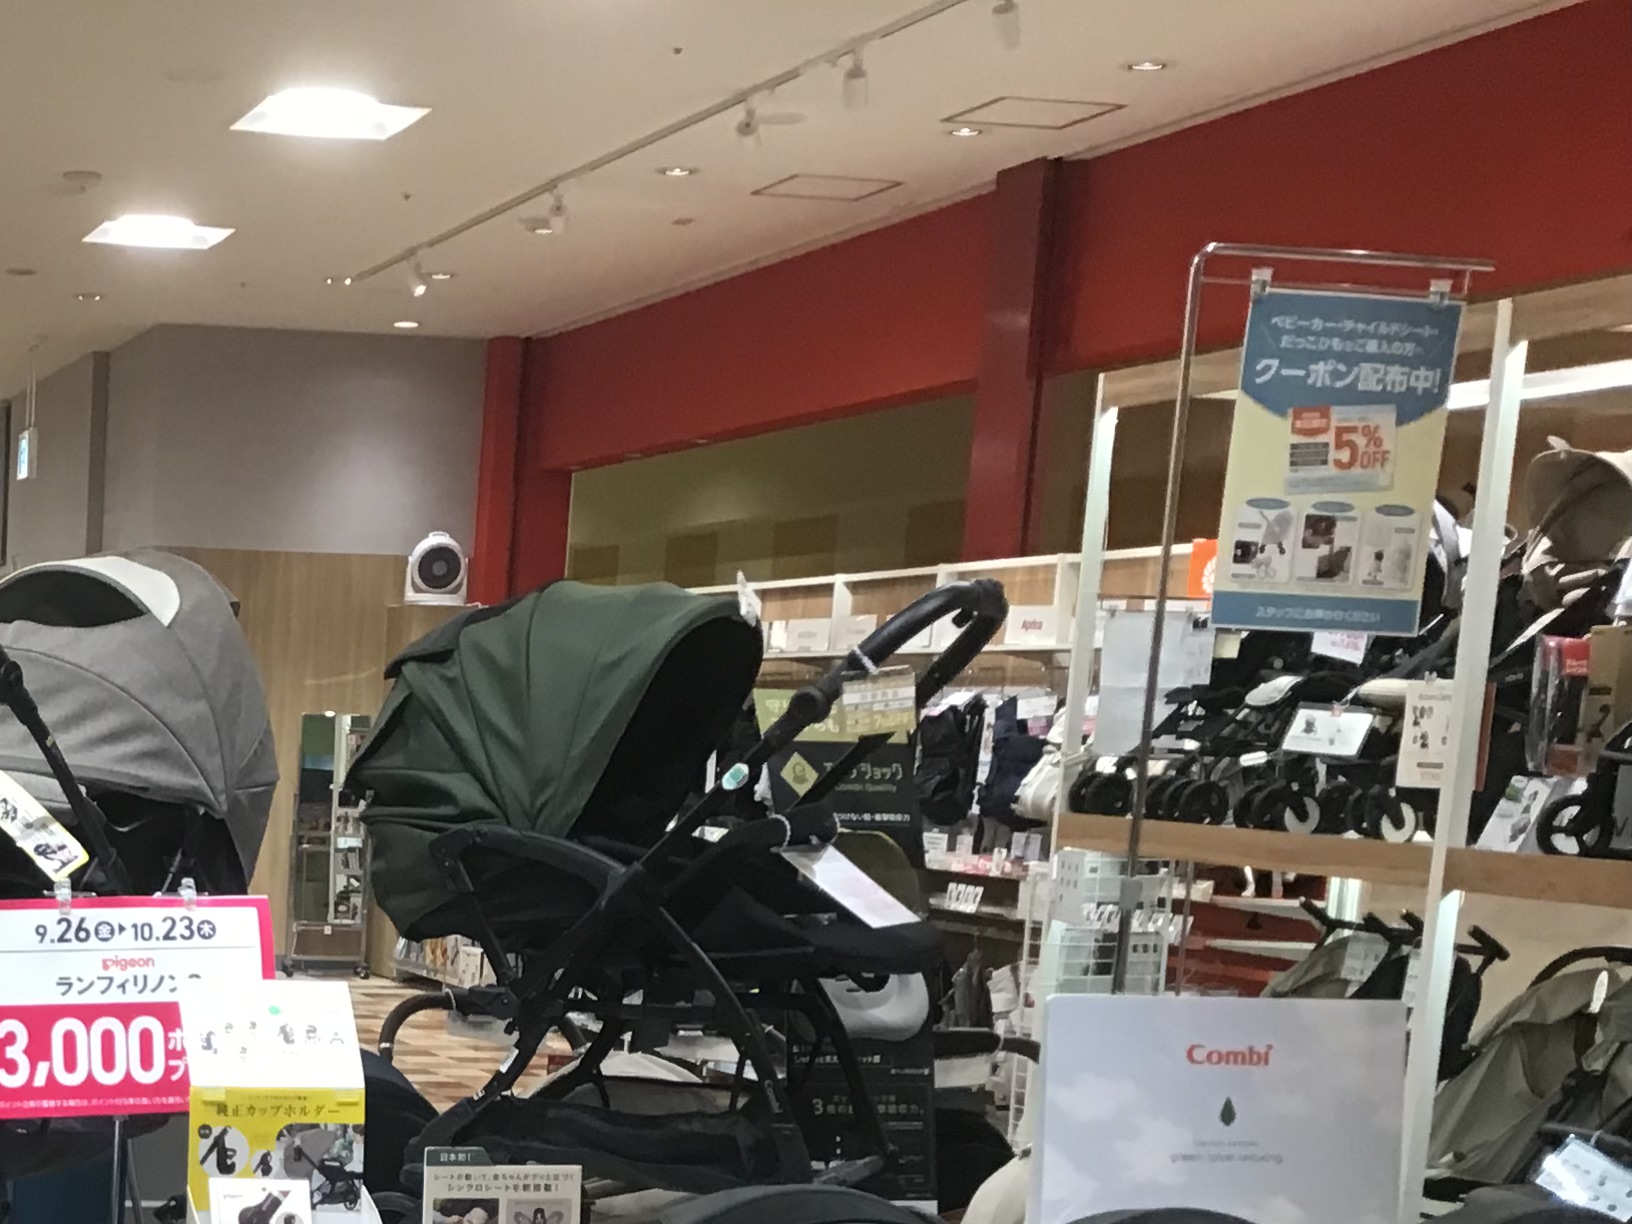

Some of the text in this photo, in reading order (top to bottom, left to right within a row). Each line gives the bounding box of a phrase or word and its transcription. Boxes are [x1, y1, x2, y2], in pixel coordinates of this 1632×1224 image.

[1255, 358, 1443, 395] クーポン配布中!
[1359, 450, 1391, 470] OFF
[101, 955, 156, 972] pigeon
[1186, 1043, 1274, 1068] Combi
[216, 1103, 341, 1118] 純正カップホルダー
